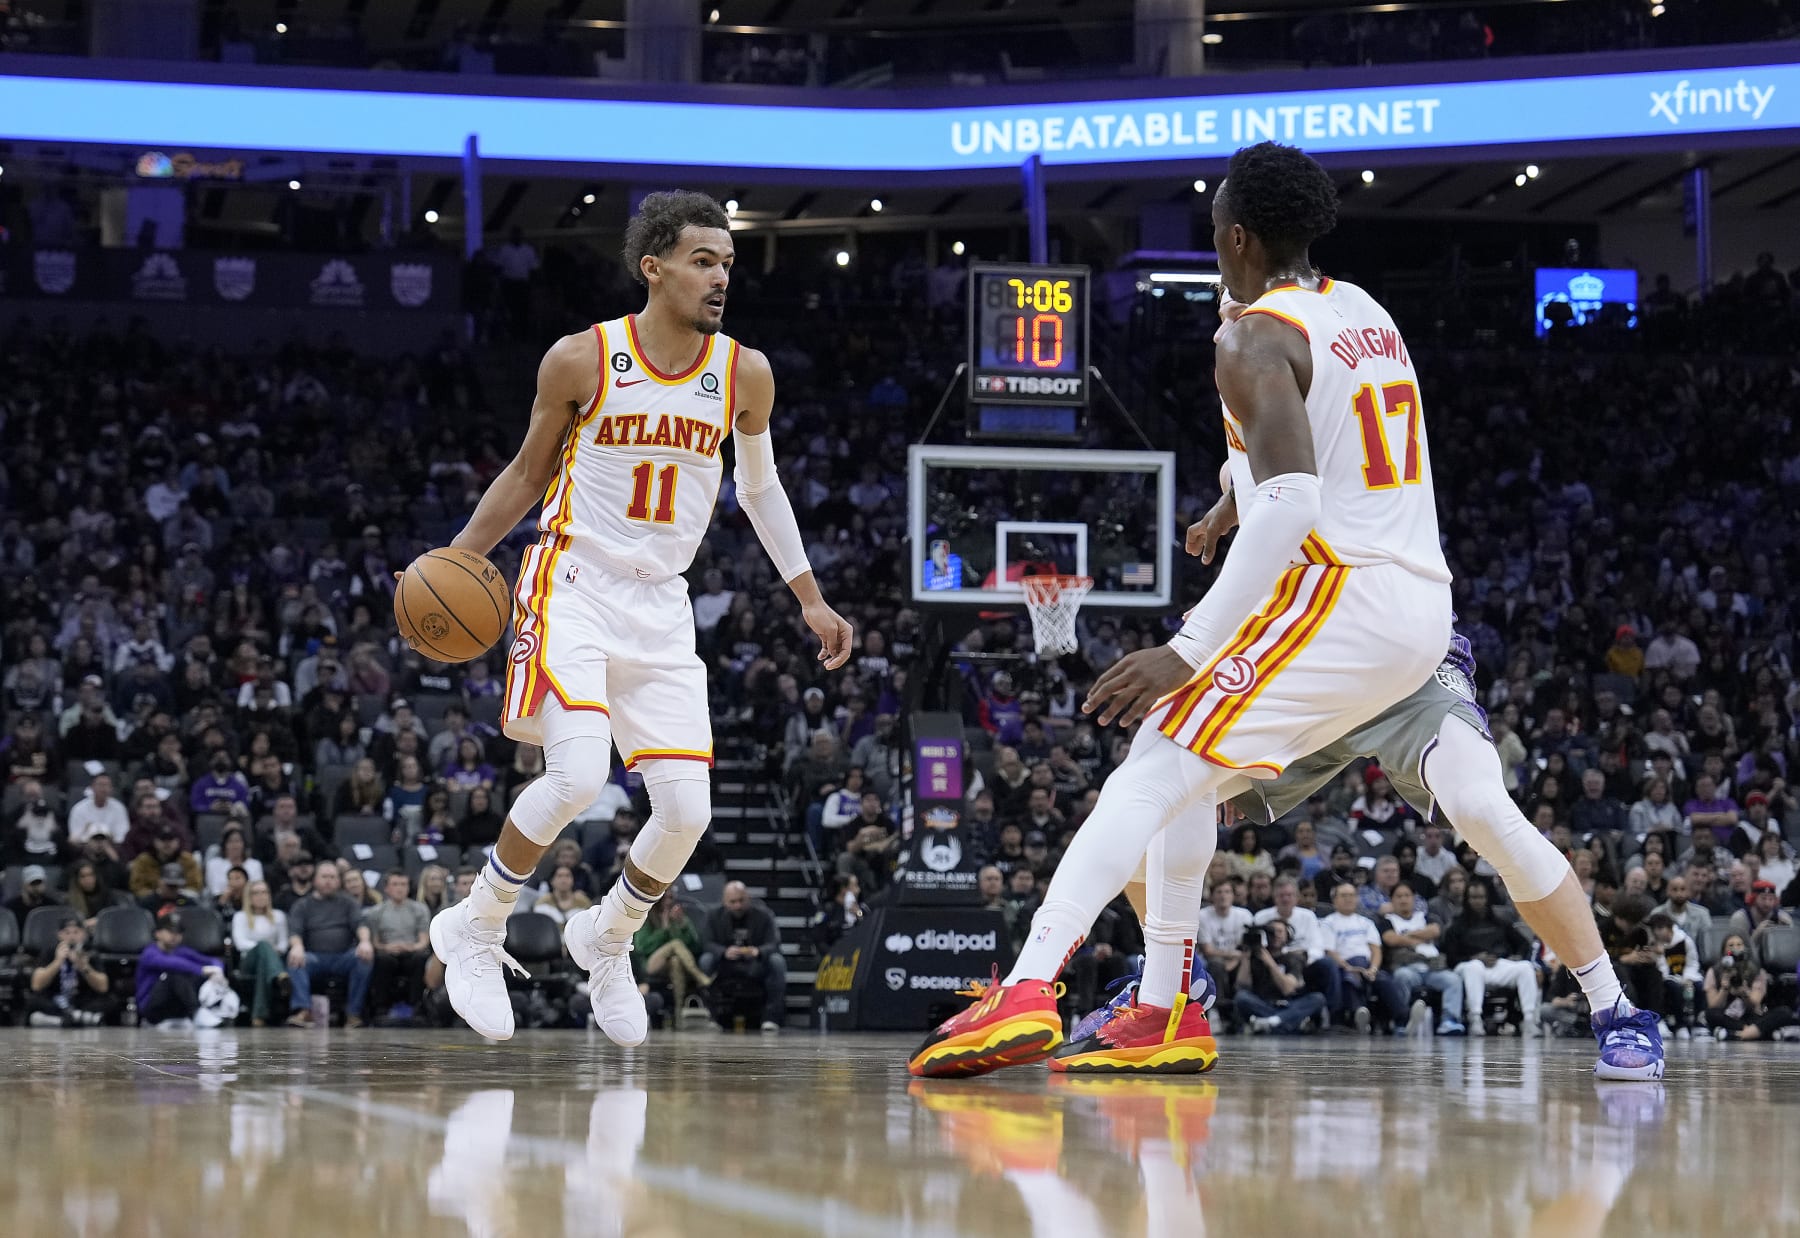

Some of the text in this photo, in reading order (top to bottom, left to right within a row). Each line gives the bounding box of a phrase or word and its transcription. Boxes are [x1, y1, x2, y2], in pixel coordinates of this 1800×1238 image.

[1649, 79, 1776, 125] xfinity
[951, 99, 1440, 154] UNBEATABLE INTERNET
[1008, 278, 1073, 313] 7:06
[1016, 314, 1063, 368] 10
[1330, 327, 1407, 370] OKGWU
[615, 357, 628, 371] 6
[1007, 376, 1082, 395] TISSOT
[594, 413, 722, 458] ATLANTA
[1352, 380, 1422, 491] 17
[626, 460, 678, 524] 11
[905, 871, 977, 884] REDHAWK
[915, 929, 996, 955] dialpad
